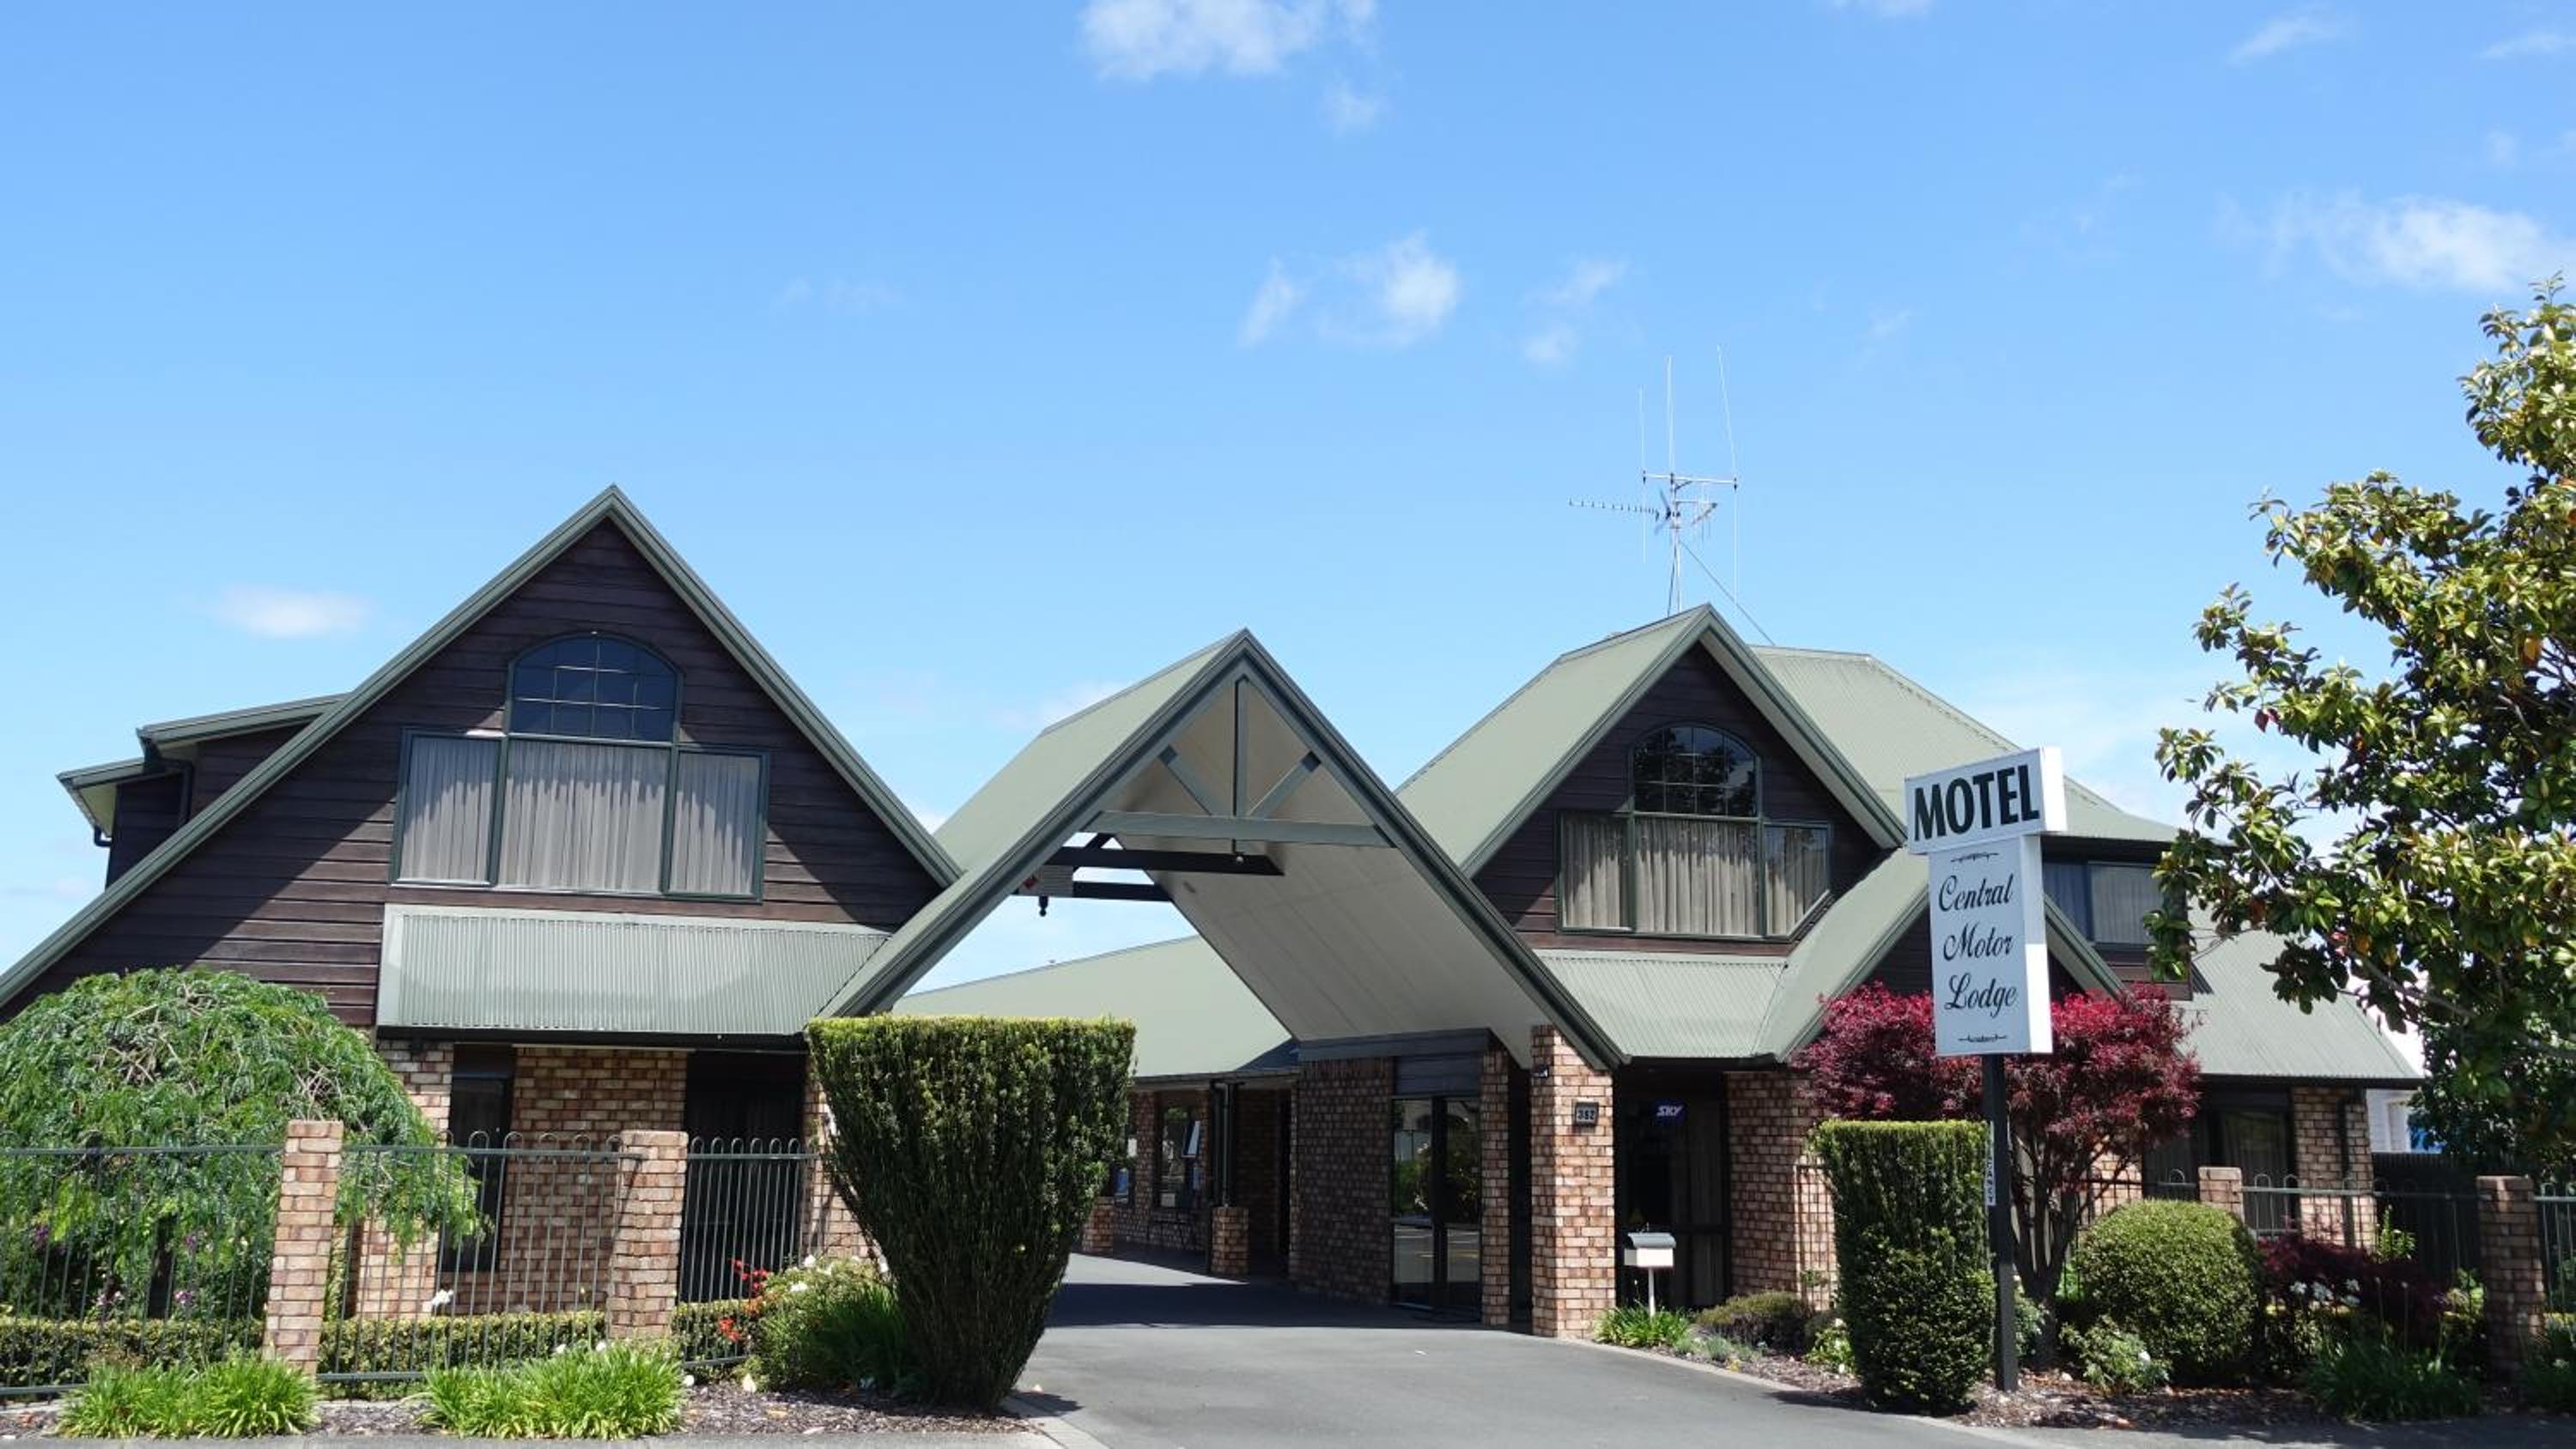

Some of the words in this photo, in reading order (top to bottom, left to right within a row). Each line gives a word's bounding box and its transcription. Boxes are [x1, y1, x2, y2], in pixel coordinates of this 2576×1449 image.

[1915, 764, 2040, 841] MOTEL
[1939, 873, 2014, 912] Central
[1943, 922, 2014, 961] Motor
[1944, 973, 2017, 1018] Lodge
